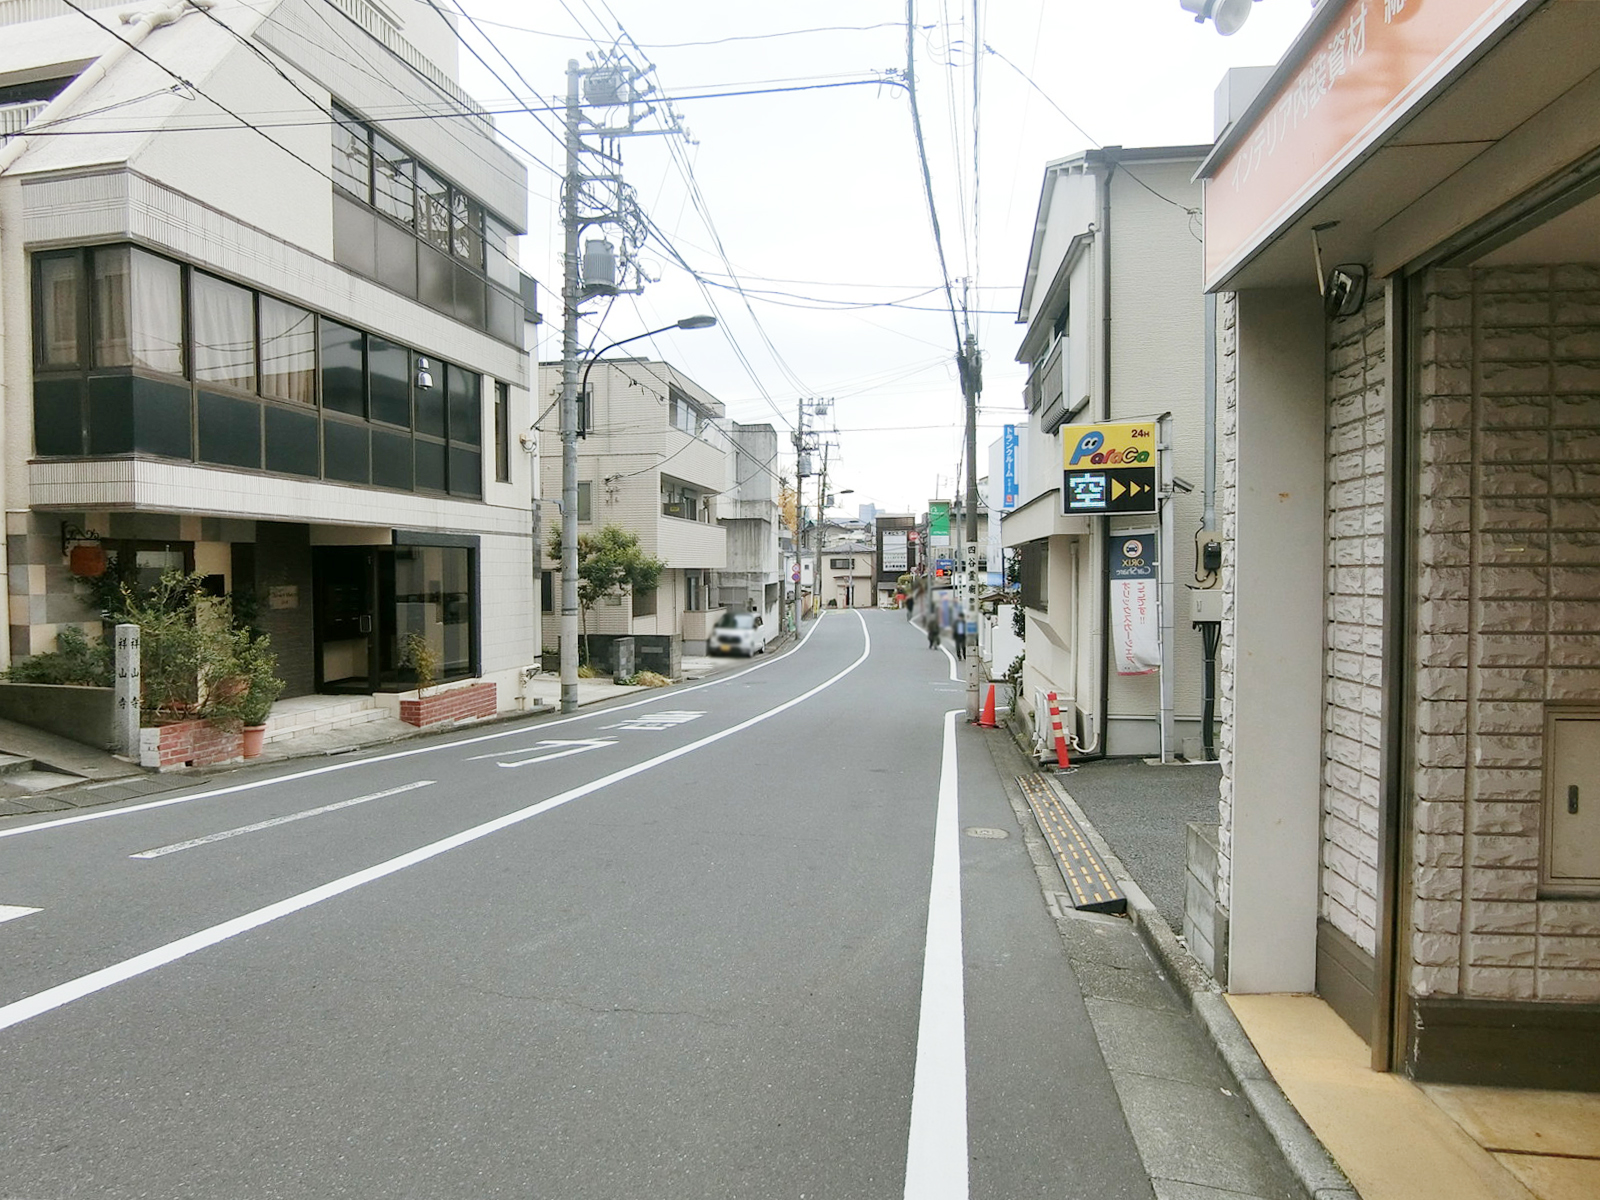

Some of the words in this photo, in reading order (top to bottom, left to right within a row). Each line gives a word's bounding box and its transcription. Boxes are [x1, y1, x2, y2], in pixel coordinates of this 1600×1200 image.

[1232, 2, 1367, 192] インテリア内装資材
[1005, 427, 1013, 477] トランクルーム
[1131, 429, 1150, 438] 24H
[1069, 473, 1106, 508] 空
[118, 637, 127, 710] 祥山寺
[130, 637, 140, 709] 祥山寺
